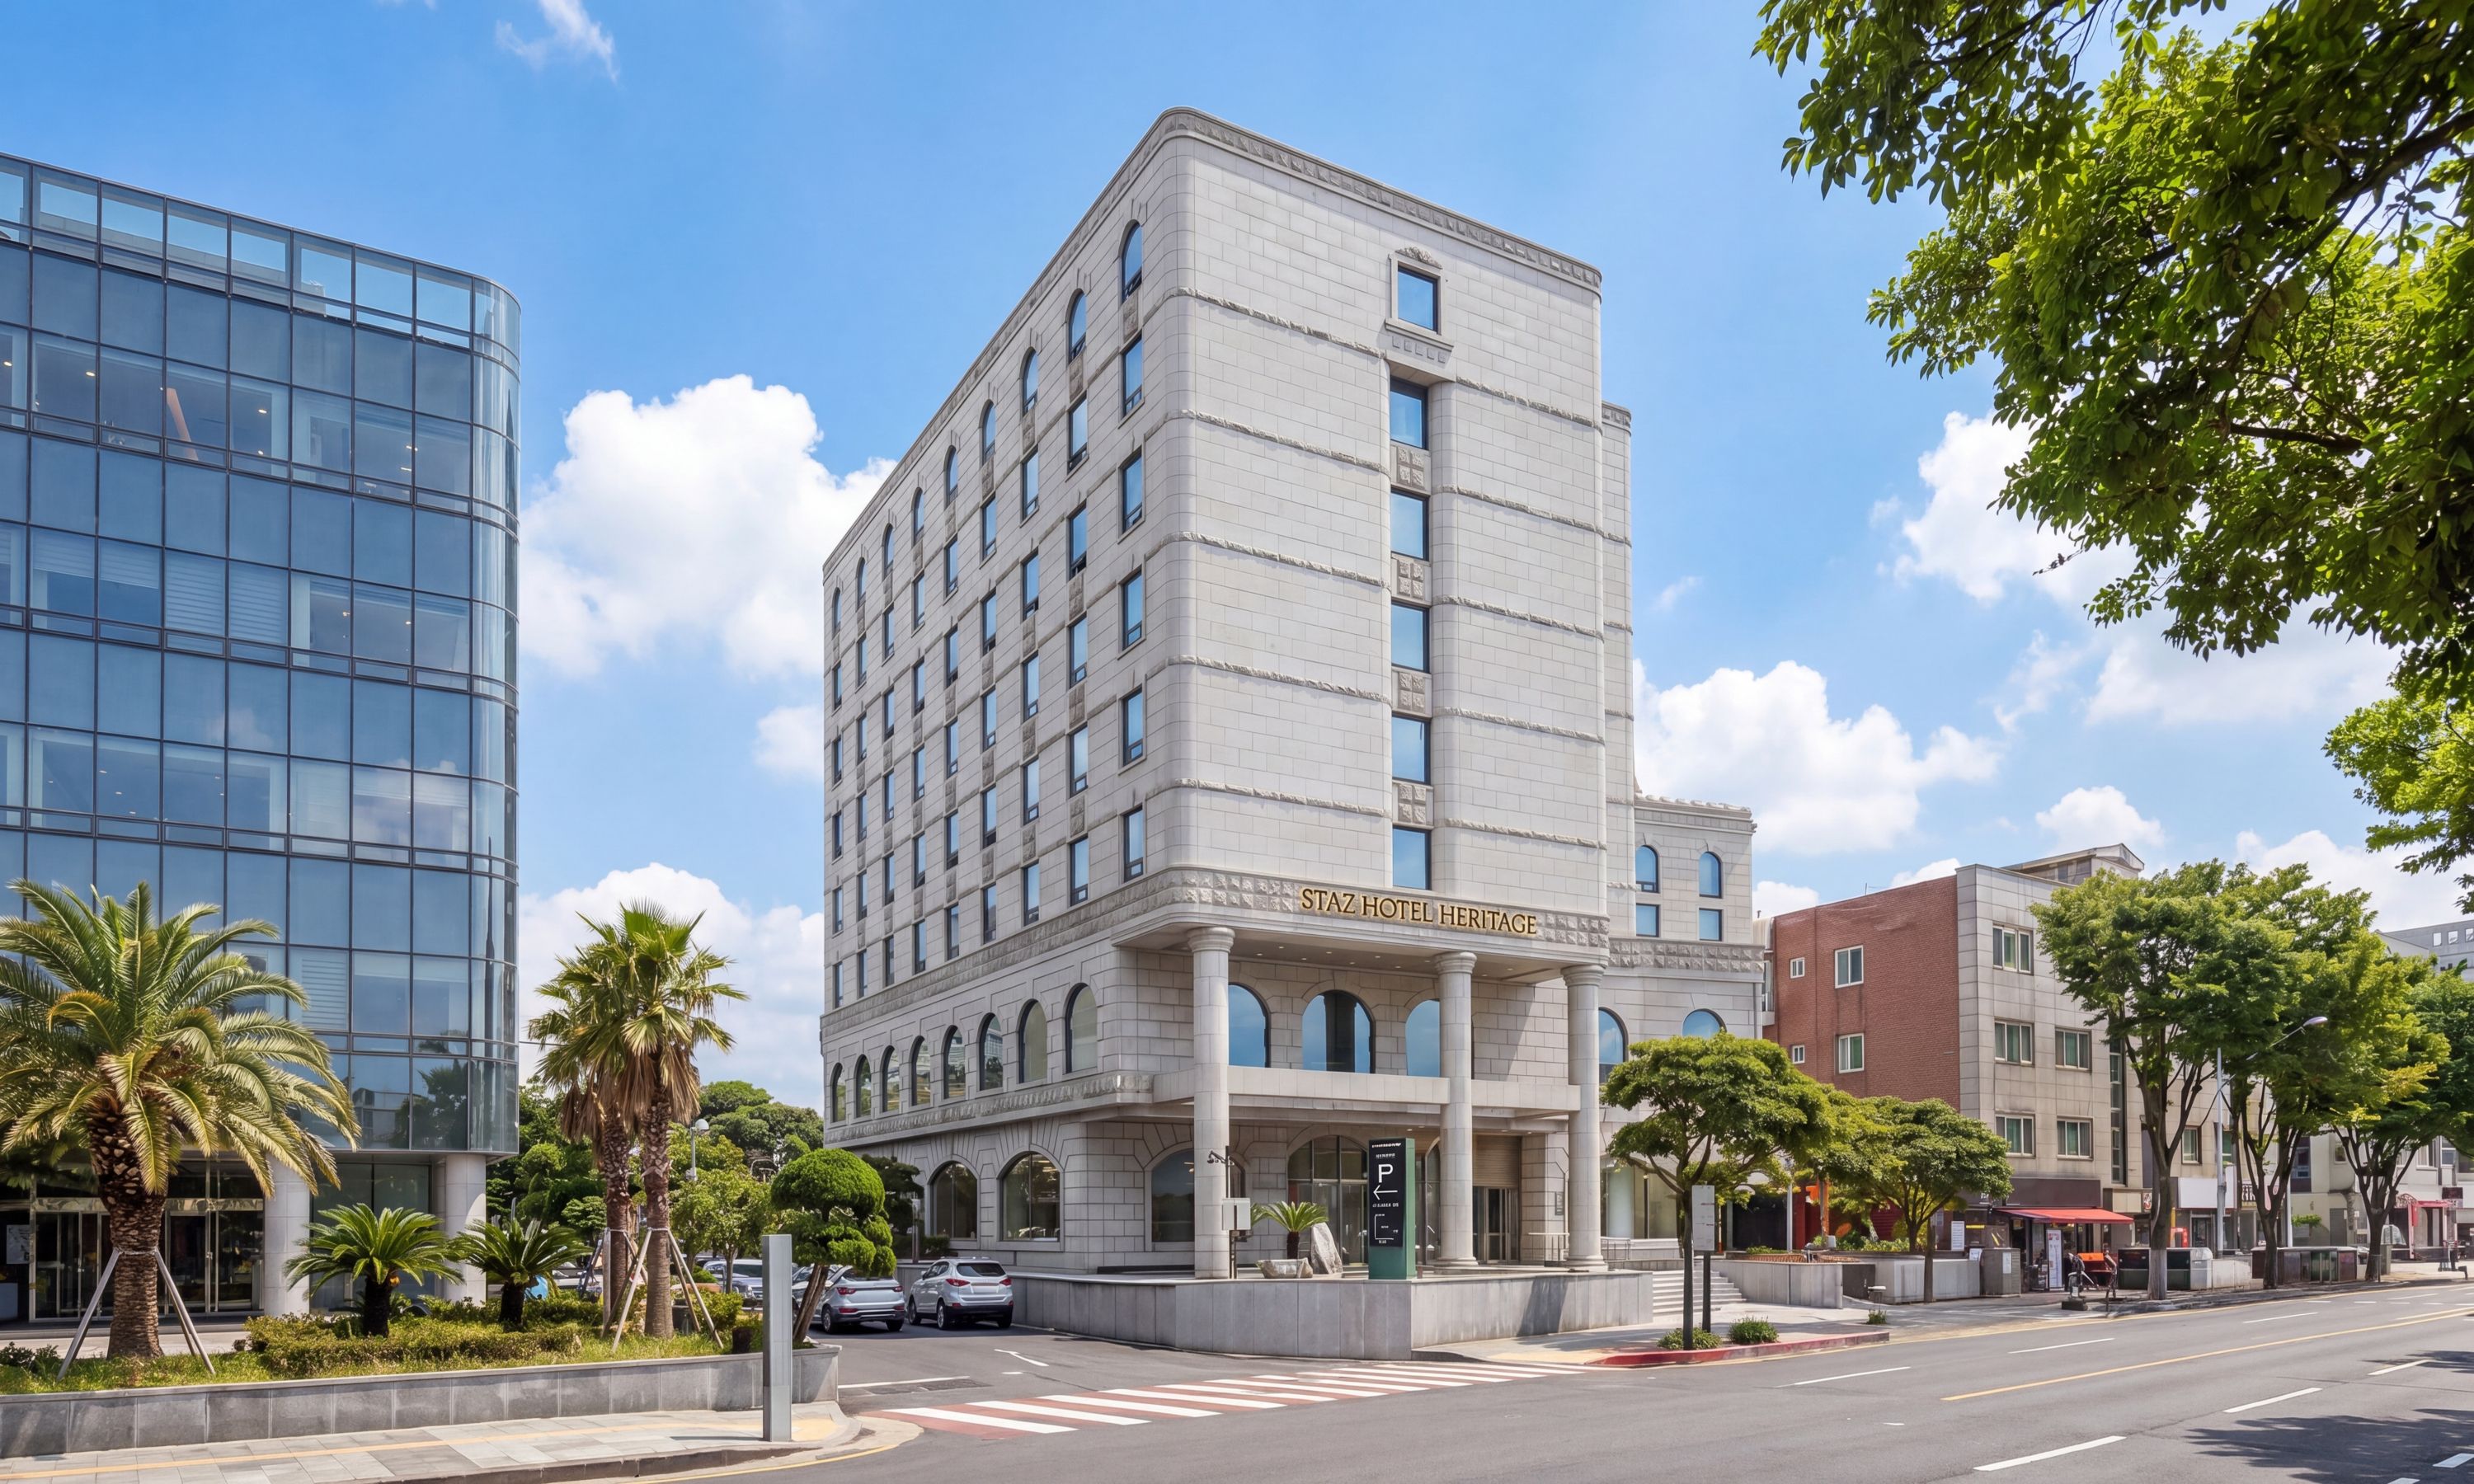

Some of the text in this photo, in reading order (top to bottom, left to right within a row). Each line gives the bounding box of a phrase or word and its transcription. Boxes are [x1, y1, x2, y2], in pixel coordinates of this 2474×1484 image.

[1301, 888, 1537, 935] STAZ HOTEL HERITAGE
[1378, 1163, 1394, 1183] P
